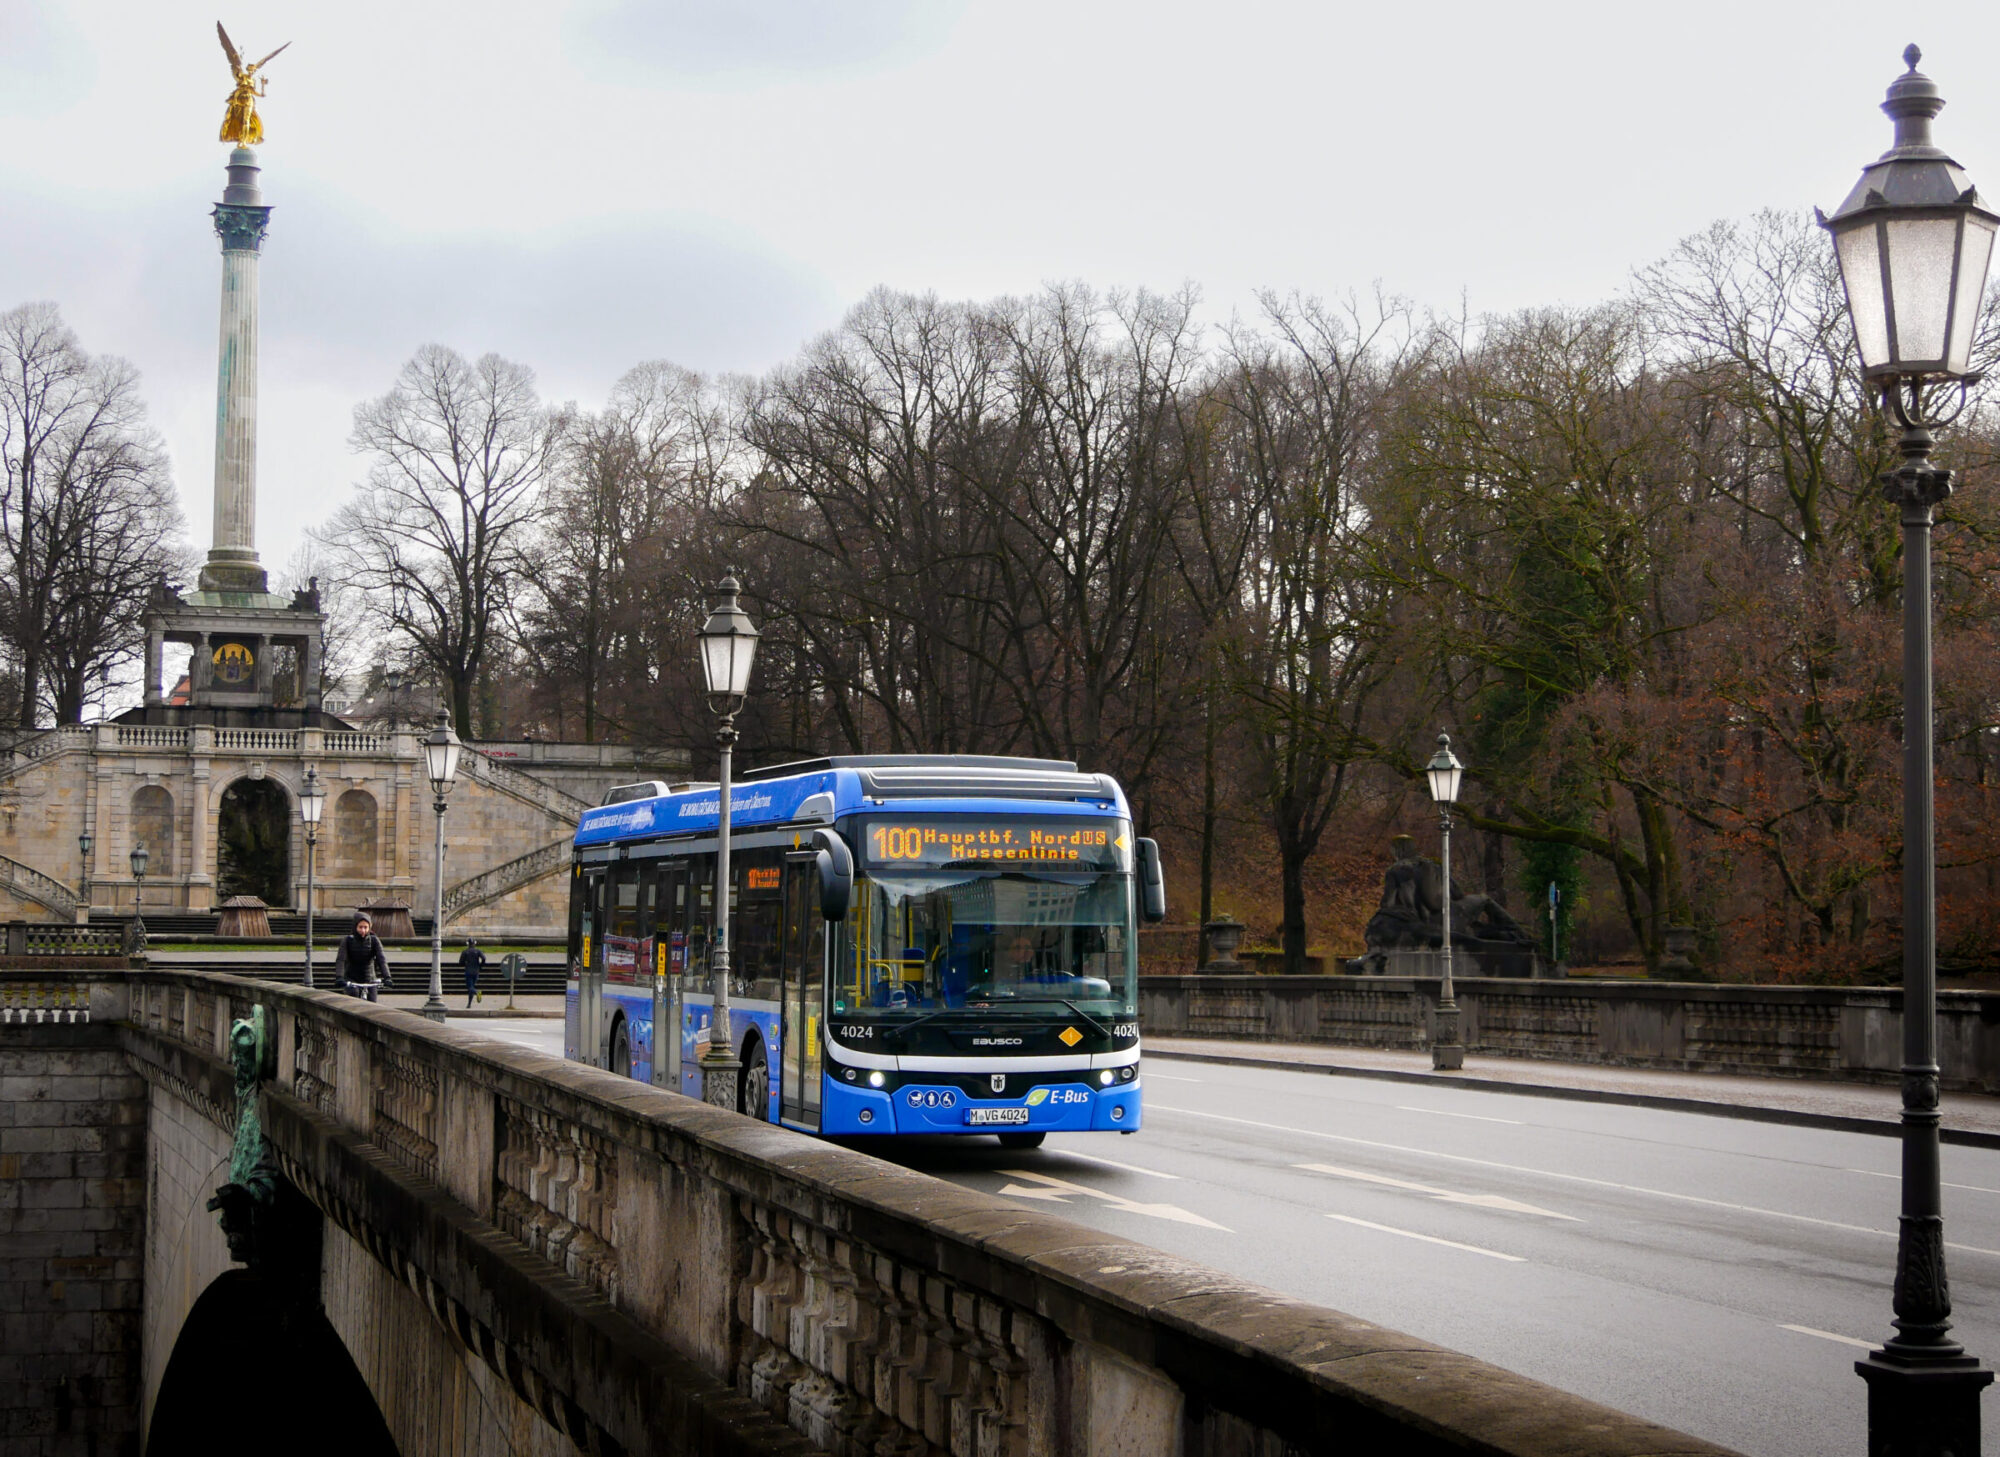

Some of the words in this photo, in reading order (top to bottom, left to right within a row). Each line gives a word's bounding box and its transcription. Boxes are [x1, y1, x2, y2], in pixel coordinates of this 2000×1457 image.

[874, 827, 922, 859] 100
[924, 829, 1019, 845] Hauptbf.
[1030, 830, 1081, 845] Nord
[951, 845, 1079, 860] Museenlinie
[840, 1026, 873, 1038] 4024
[1113, 1025, 1137, 1037] 4024
[1050, 1090, 1089, 1104] E-Bus
[970, 1110, 978, 1121] M
[985, 1110, 998, 1121] VG
[1001, 1109, 1026, 1121] 4024
